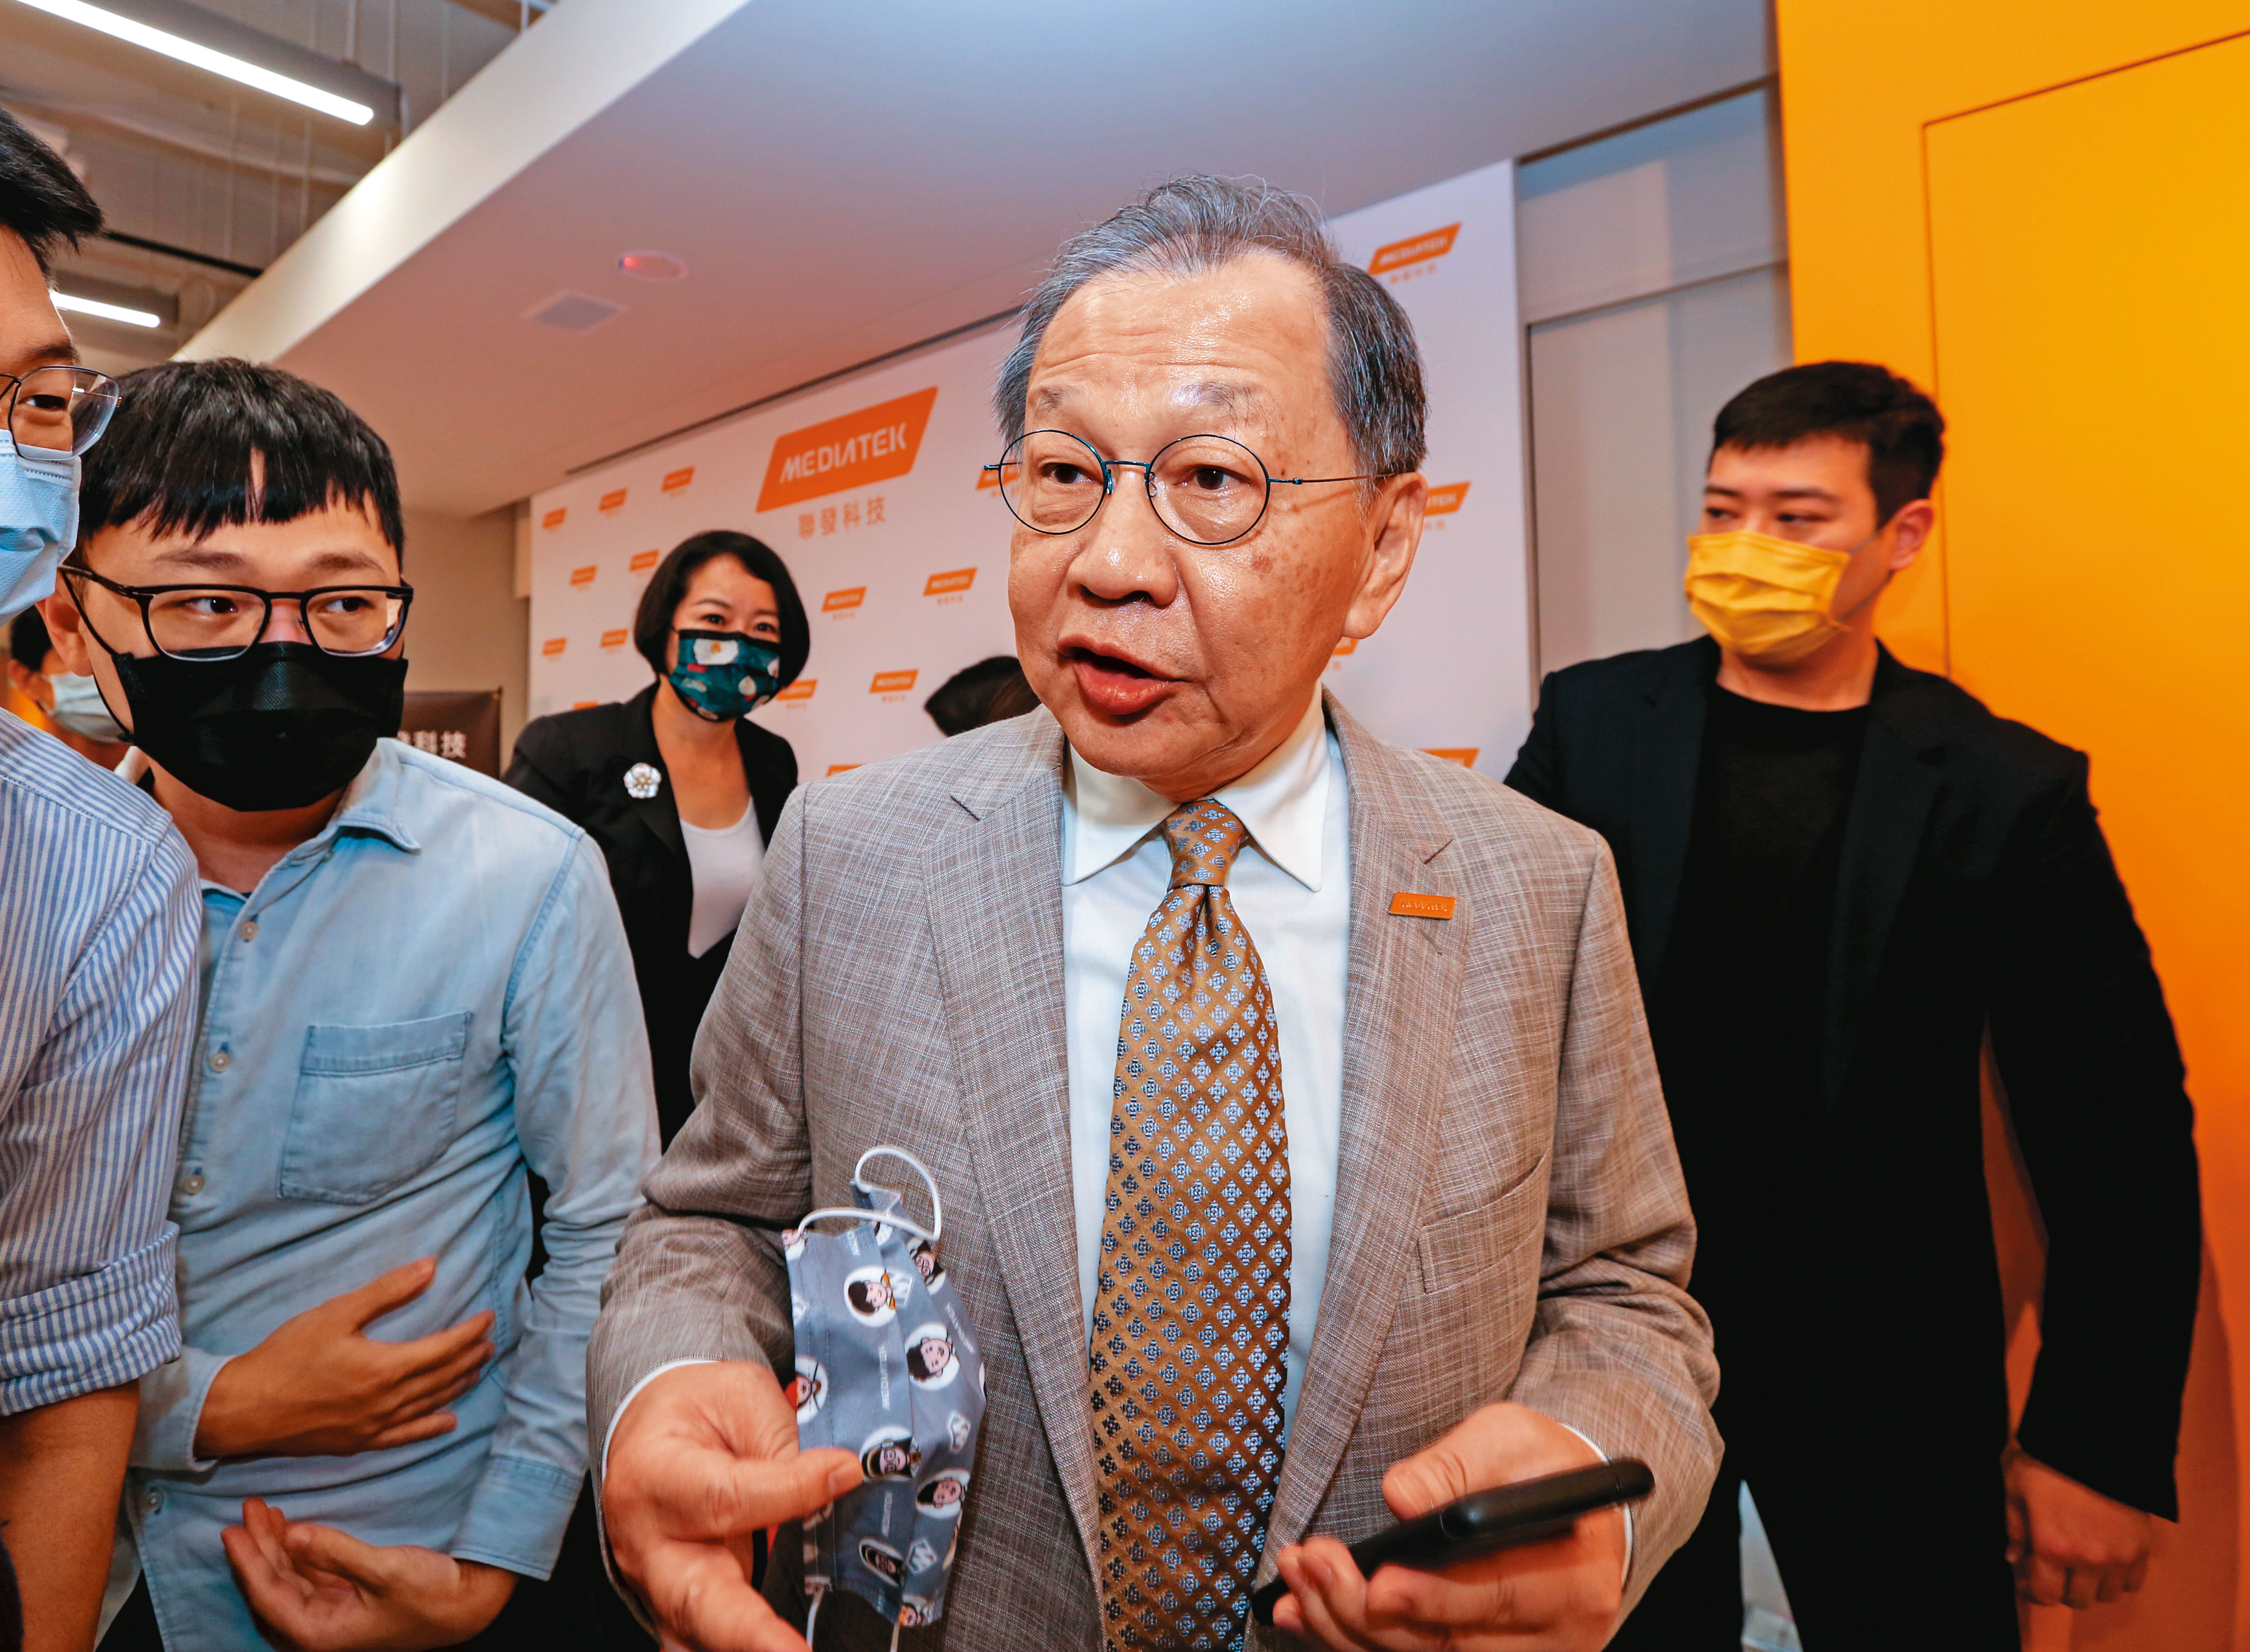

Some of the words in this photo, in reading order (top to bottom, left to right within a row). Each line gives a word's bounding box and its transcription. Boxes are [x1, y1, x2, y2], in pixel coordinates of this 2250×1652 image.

[780, 422, 907, 484] MEDIATEK
[798, 494, 885, 540] 聯發科技
[879, 1344, 890, 1411] MEDIATEK
